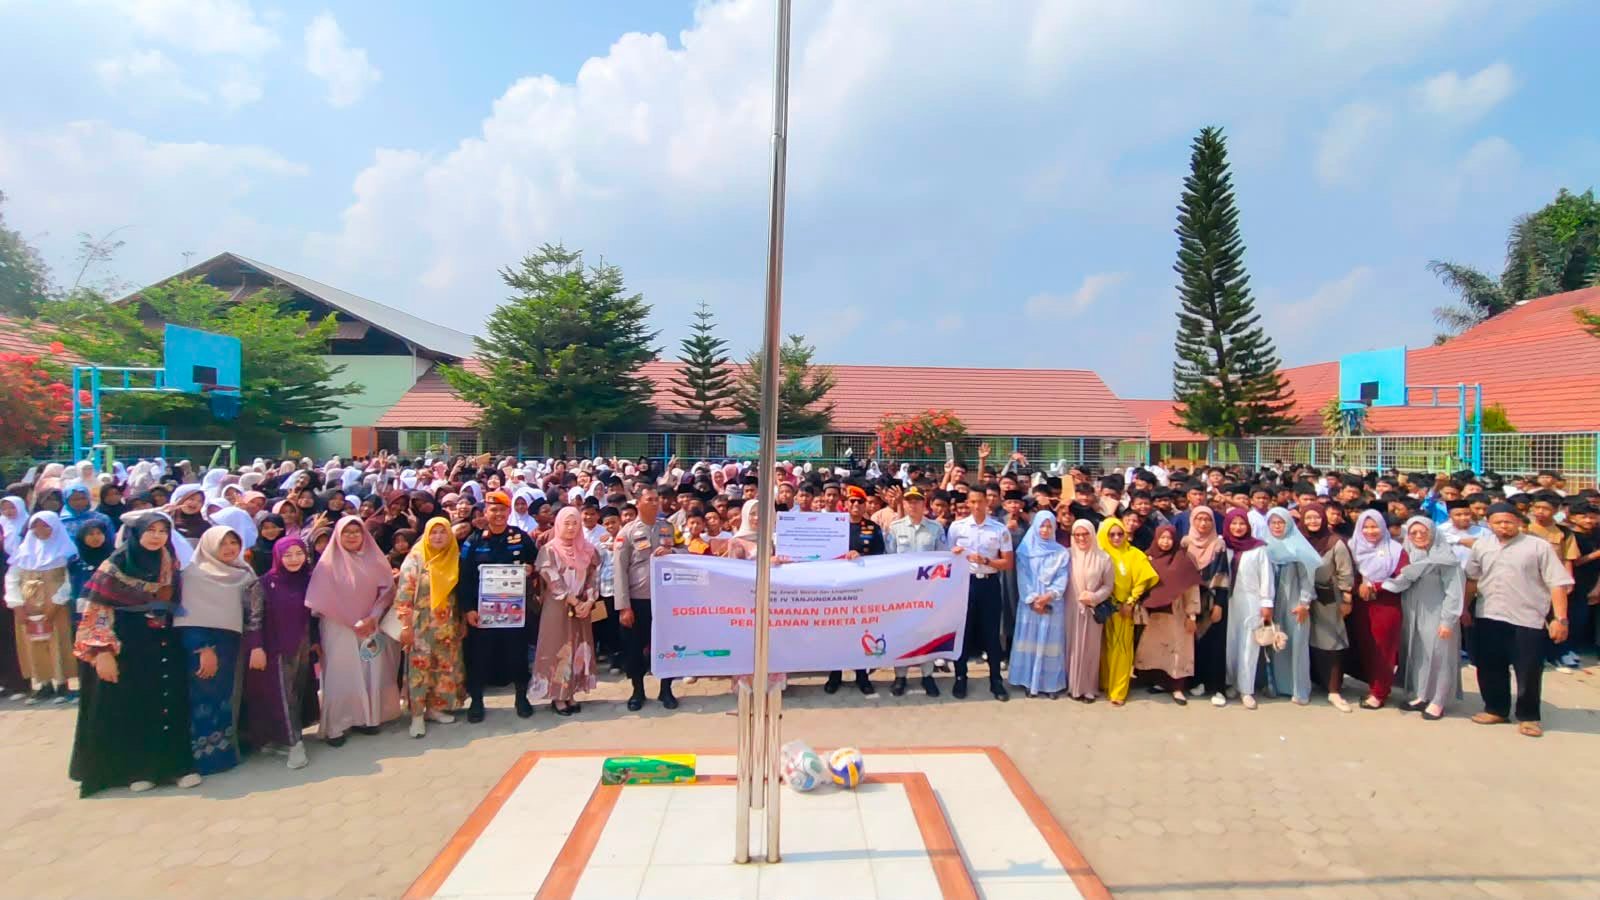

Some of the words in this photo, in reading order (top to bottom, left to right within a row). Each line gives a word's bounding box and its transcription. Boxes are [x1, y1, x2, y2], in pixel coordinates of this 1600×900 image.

[672, 606, 746, 617] SOSIALISASI
[823, 606, 849, 616] DAN
[853, 600, 935, 615] KESELAMATAN
[730, 618, 809, 627] PERLANAN
[813, 617, 856, 626] KERETA
[861, 615, 879, 624] API
